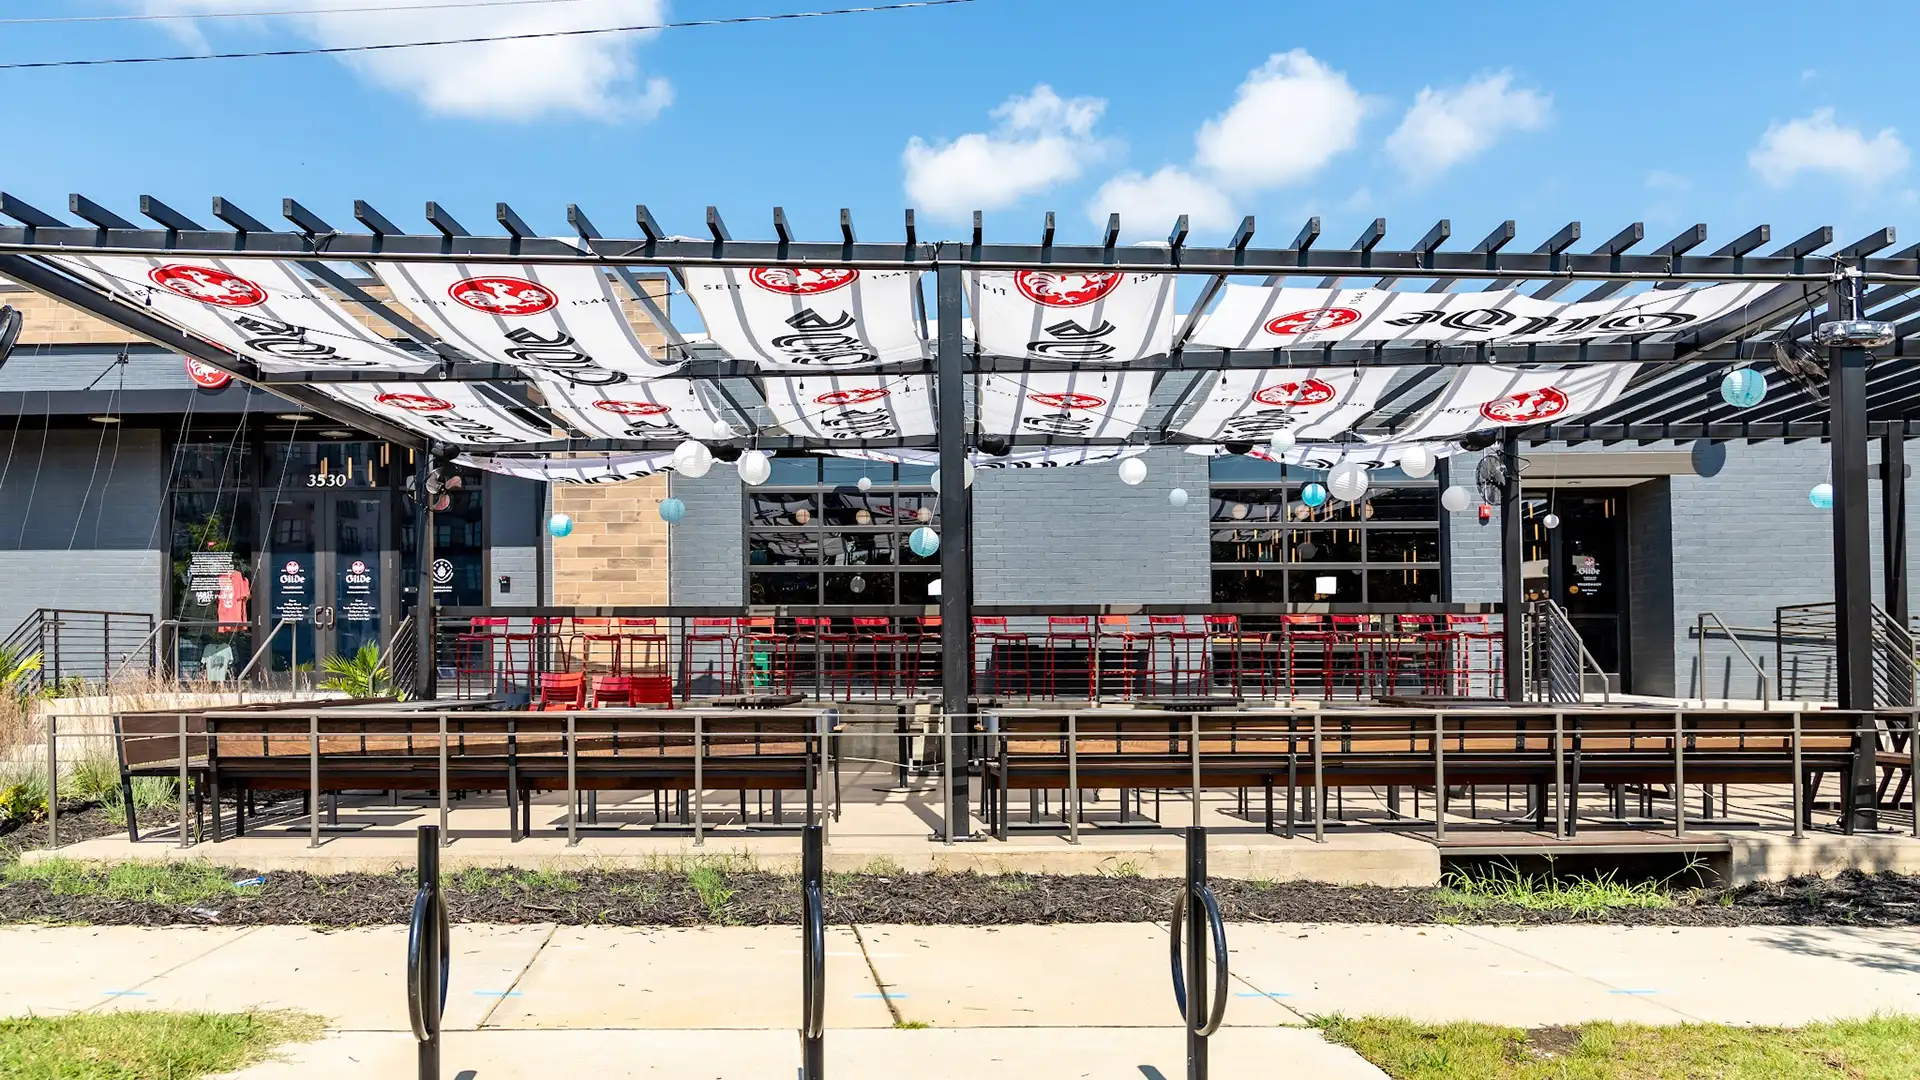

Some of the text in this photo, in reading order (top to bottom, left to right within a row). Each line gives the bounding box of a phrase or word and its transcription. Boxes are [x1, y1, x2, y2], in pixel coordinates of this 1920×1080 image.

[1132, 271, 1159, 284] 154
[703, 283, 742, 291] SEIT
[306, 473, 347, 487] 3530
